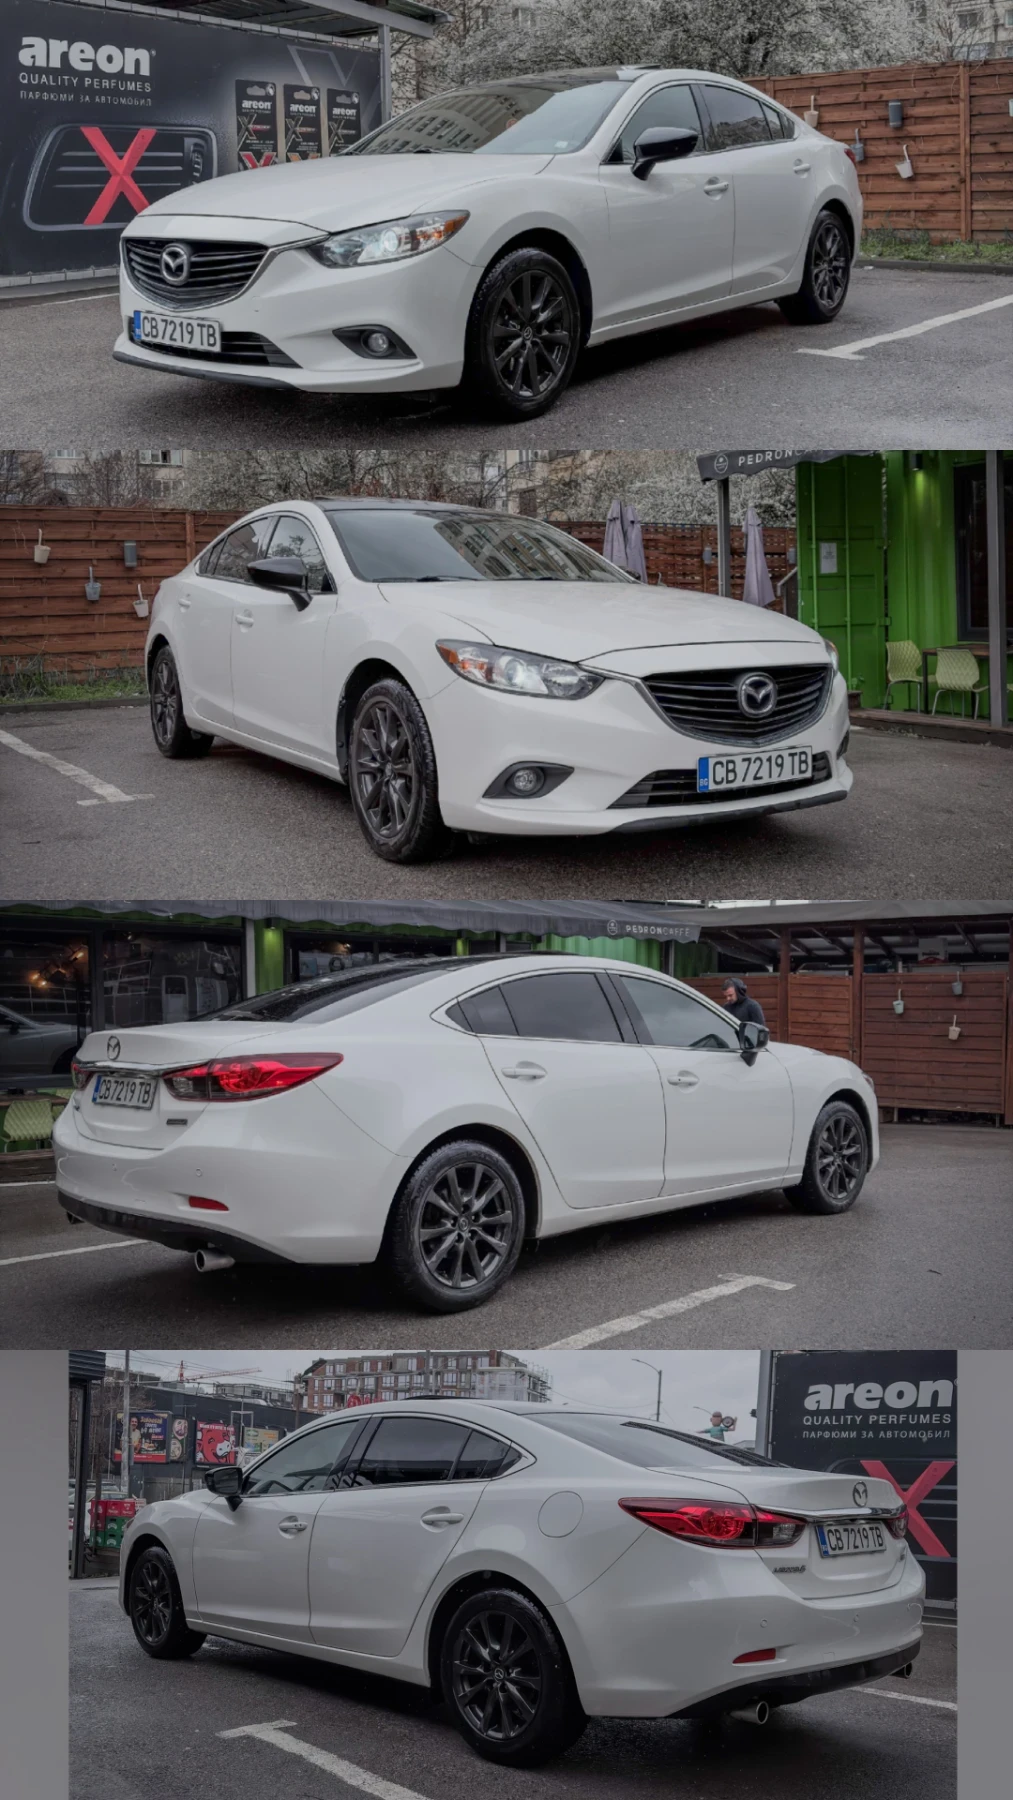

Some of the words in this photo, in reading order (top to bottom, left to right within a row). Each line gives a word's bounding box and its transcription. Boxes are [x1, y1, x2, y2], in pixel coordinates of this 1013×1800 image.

[19, 36, 151, 76] areon
[19, 72, 79, 87] QUALITY
[84, 78, 152, 92] PERFUMES
[20, 90, 74, 103] ПАРФЮМИ
[95, 96, 152, 106] АВТОМОБИЛ
[242, 100, 271, 109] areon
[290, 104, 316, 113] areon
[804, 1379, 954, 1411] areon
[803, 1414, 863, 1426] QUALITY
[868, 1413, 952, 1425] PERFUMES
[802, 1429, 857, 1439] ПАРФЮМИ
[861, 1430, 874, 1439] ЗА
[878, 1429, 951, 1439] АВТОМОБИЛ
